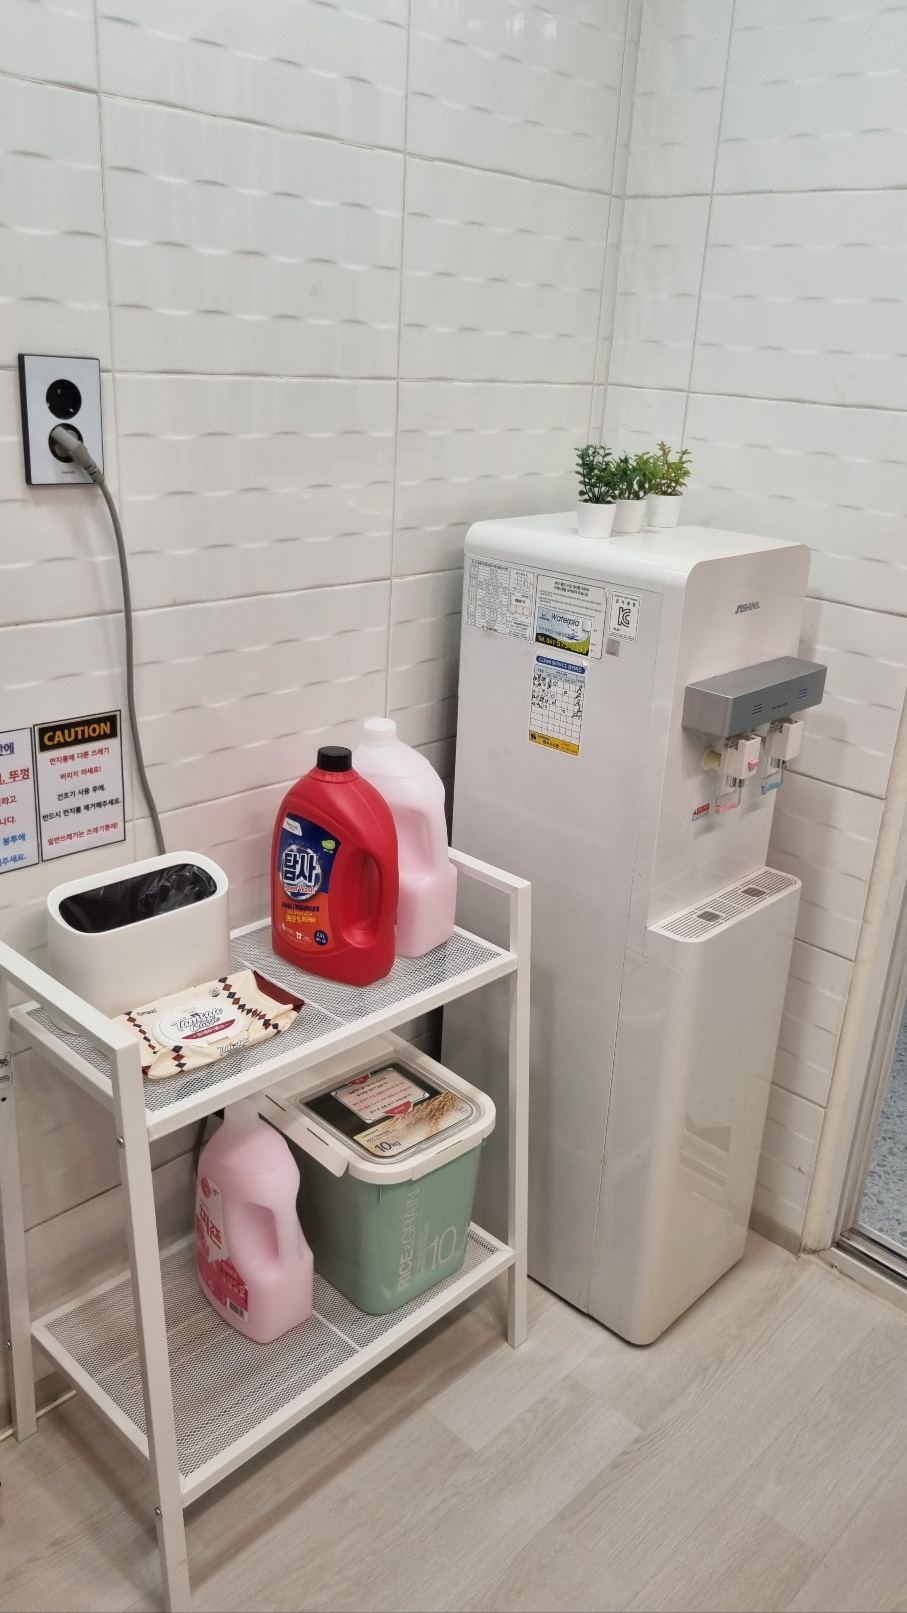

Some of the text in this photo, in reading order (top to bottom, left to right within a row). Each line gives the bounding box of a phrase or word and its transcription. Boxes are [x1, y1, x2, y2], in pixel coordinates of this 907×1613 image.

[43, 721, 111, 746] CAUTION
[77, 750, 90, 761] 다른
[91, 747, 110, 758] 쓰레기
[9, 767, 30, 783] 뚜껑
[60, 769, 79, 781] 버리지
[57, 790, 76, 802] 건조기
[77, 787, 90, 797] 사용
[42, 810, 61, 822] 반드시
[63, 805, 82, 818] 먼지를
[47, 830, 85, 846] 일반쓰레기는
[283, 852, 317, 885] 탐사
[374, 1141, 402, 1153] 10kg
[397, 1249, 414, 1291] RICE
